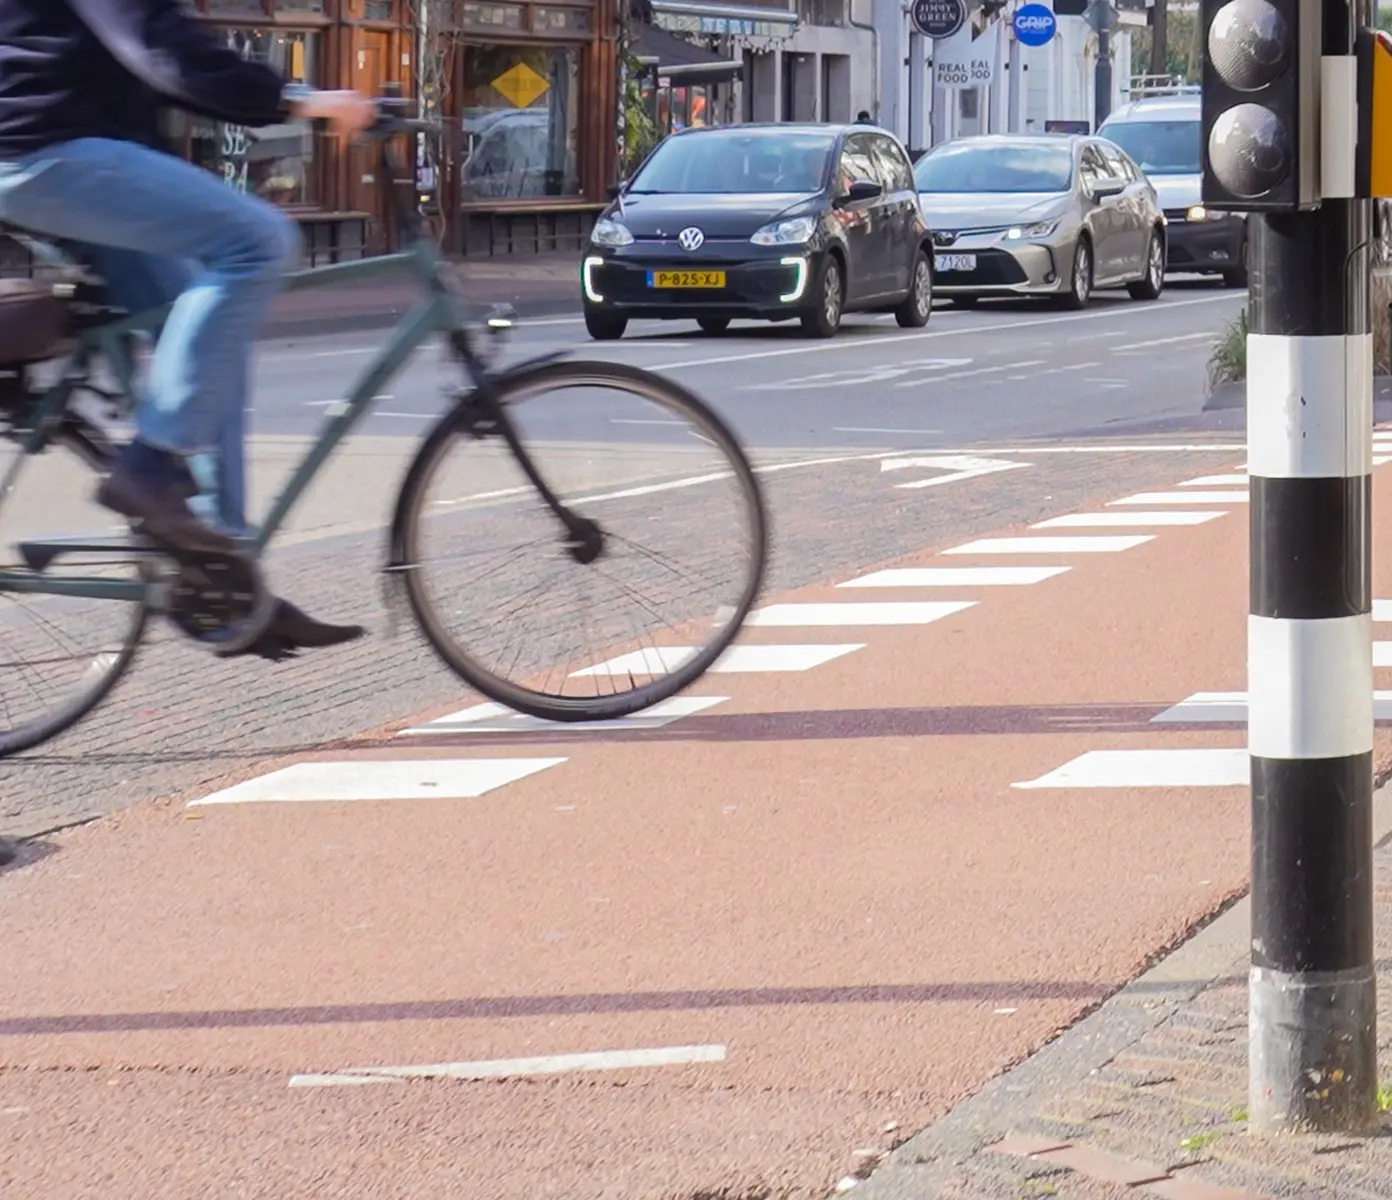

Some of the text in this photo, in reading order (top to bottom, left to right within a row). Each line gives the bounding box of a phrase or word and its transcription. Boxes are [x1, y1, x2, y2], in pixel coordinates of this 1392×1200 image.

[919, 13, 956, 21] GREEN
[1016, 16, 1052, 29] GRIP
[938, 63, 967, 73] REAL
[971, 60, 990, 69] EAL
[937, 74, 968, 83] FOOD
[659, 272, 719, 286] P-825-XJ
